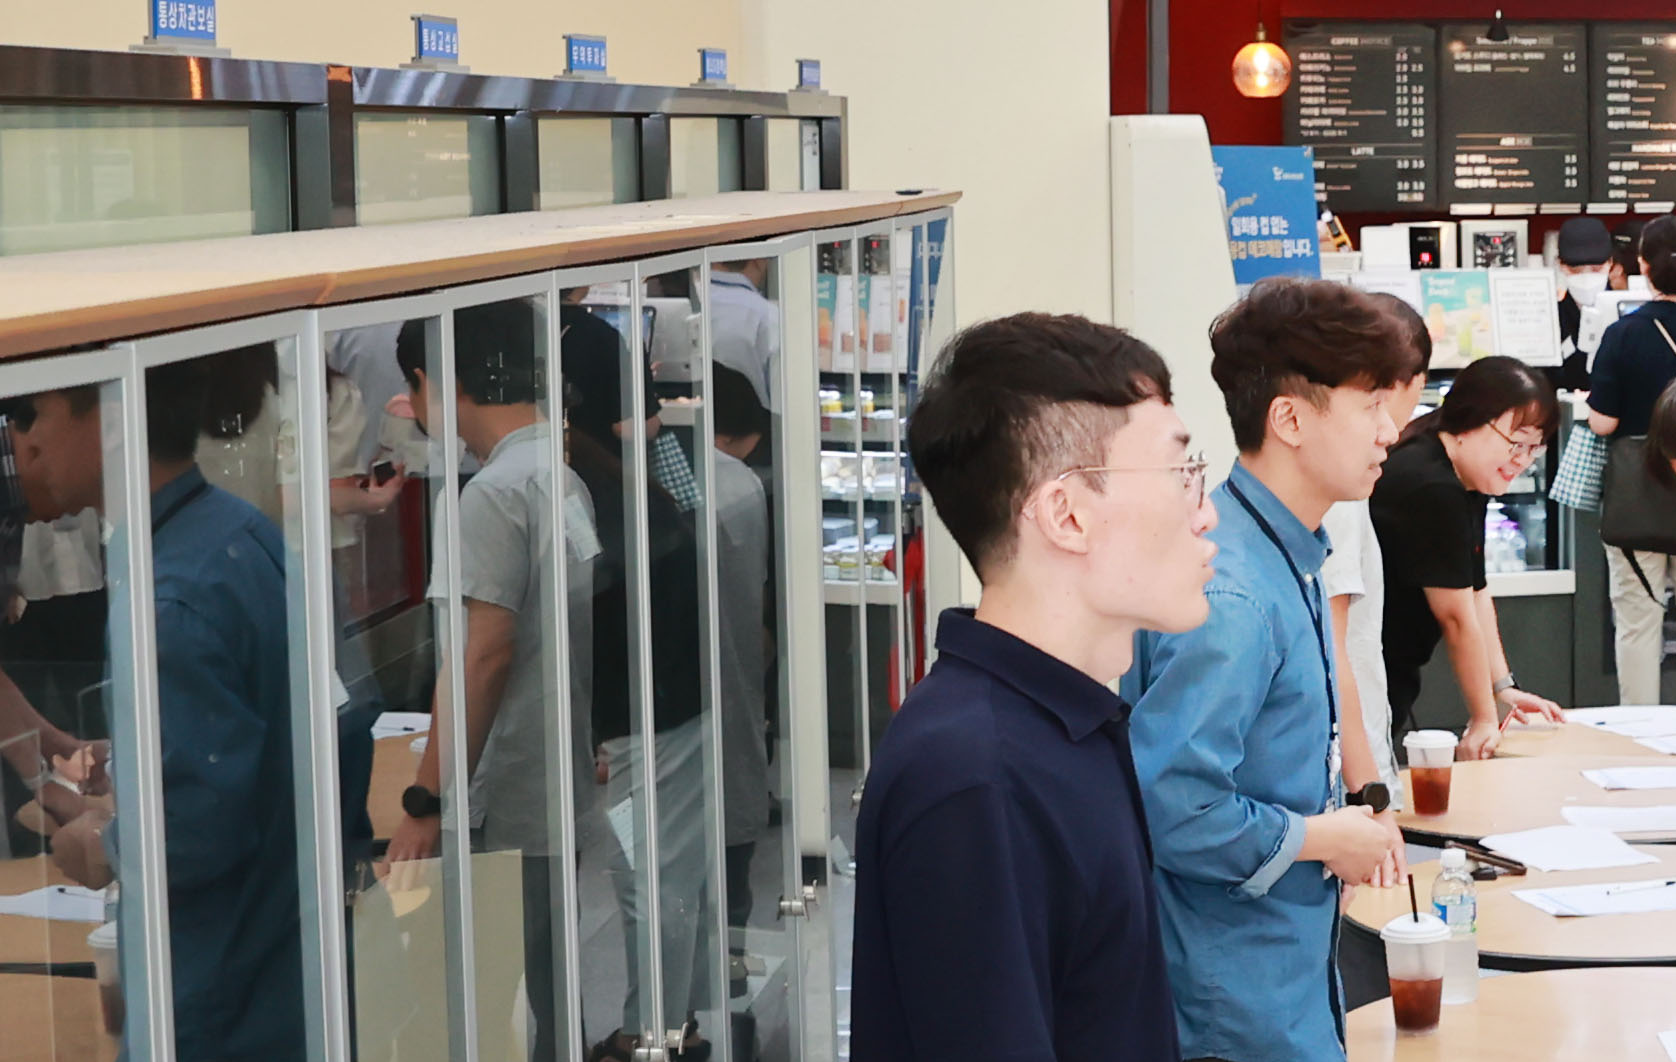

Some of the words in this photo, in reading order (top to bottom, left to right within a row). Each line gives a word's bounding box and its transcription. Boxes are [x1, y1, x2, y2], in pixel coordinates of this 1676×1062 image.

[158, 1, 215, 33] 통상차관보실
[1351, 147, 1375, 156] LATTE
[1231, 216, 1259, 236] 일회용
[1260, 216, 1270, 235] 컵
[1270, 216, 1289, 235] 없는
